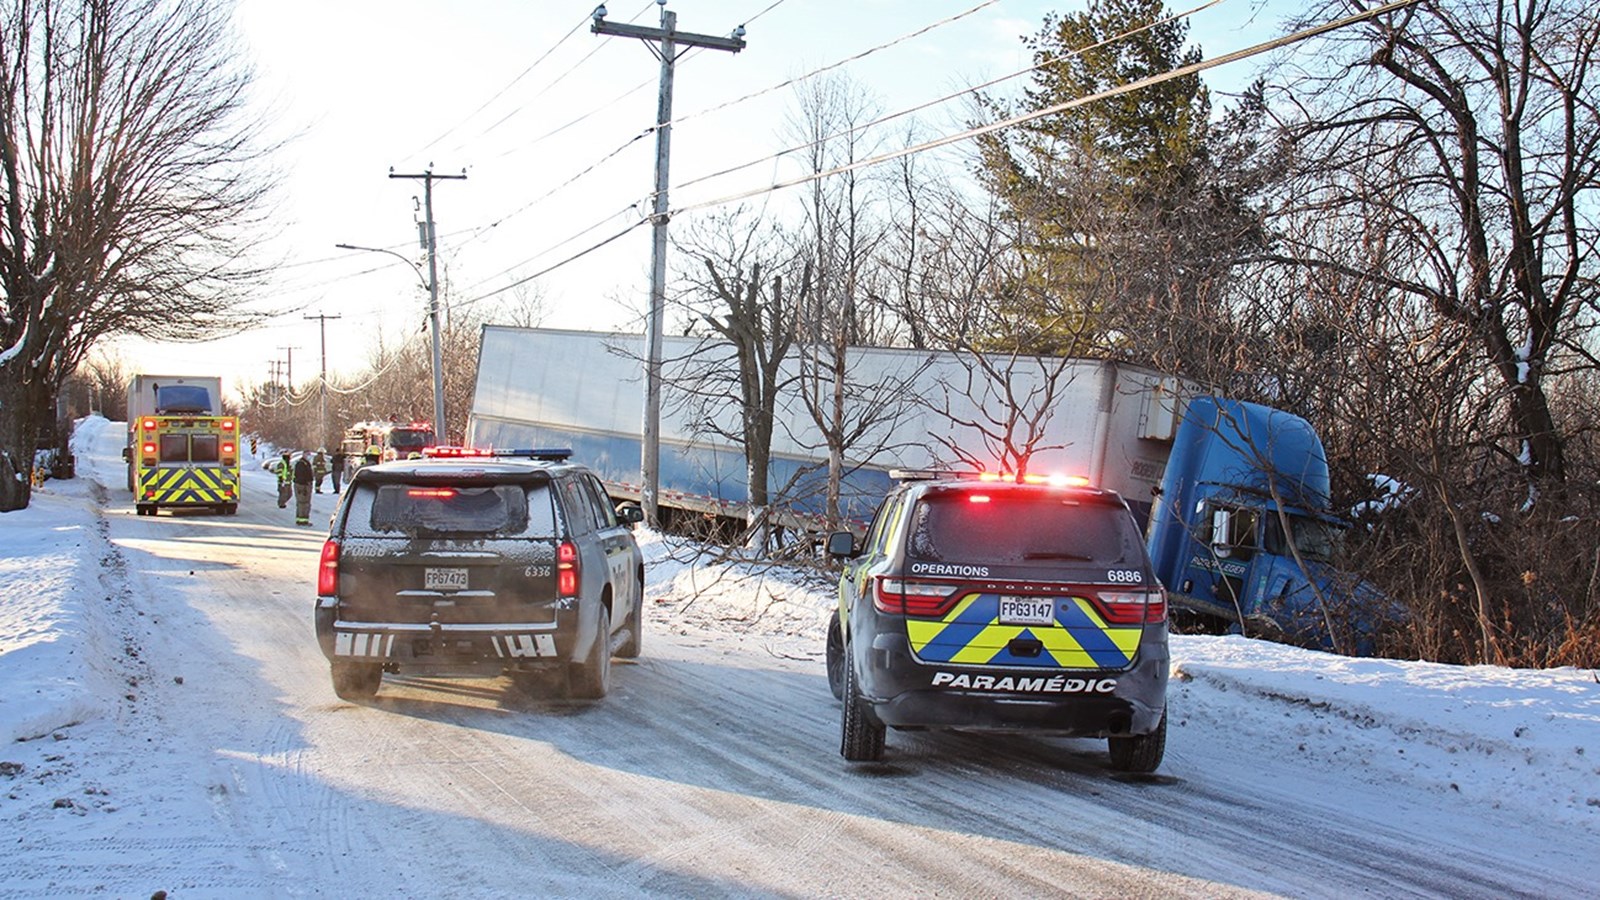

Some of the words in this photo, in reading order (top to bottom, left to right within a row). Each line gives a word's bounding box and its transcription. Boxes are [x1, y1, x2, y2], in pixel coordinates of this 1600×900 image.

[524, 566, 551, 577] 6336
[911, 563, 989, 577] OPERATIONS
[1107, 570, 1142, 583] 6886
[426, 572, 467, 585] FPG7473
[1002, 602, 1052, 617] FPG3147
[931, 672, 1117, 693] PARAMÉDIC
